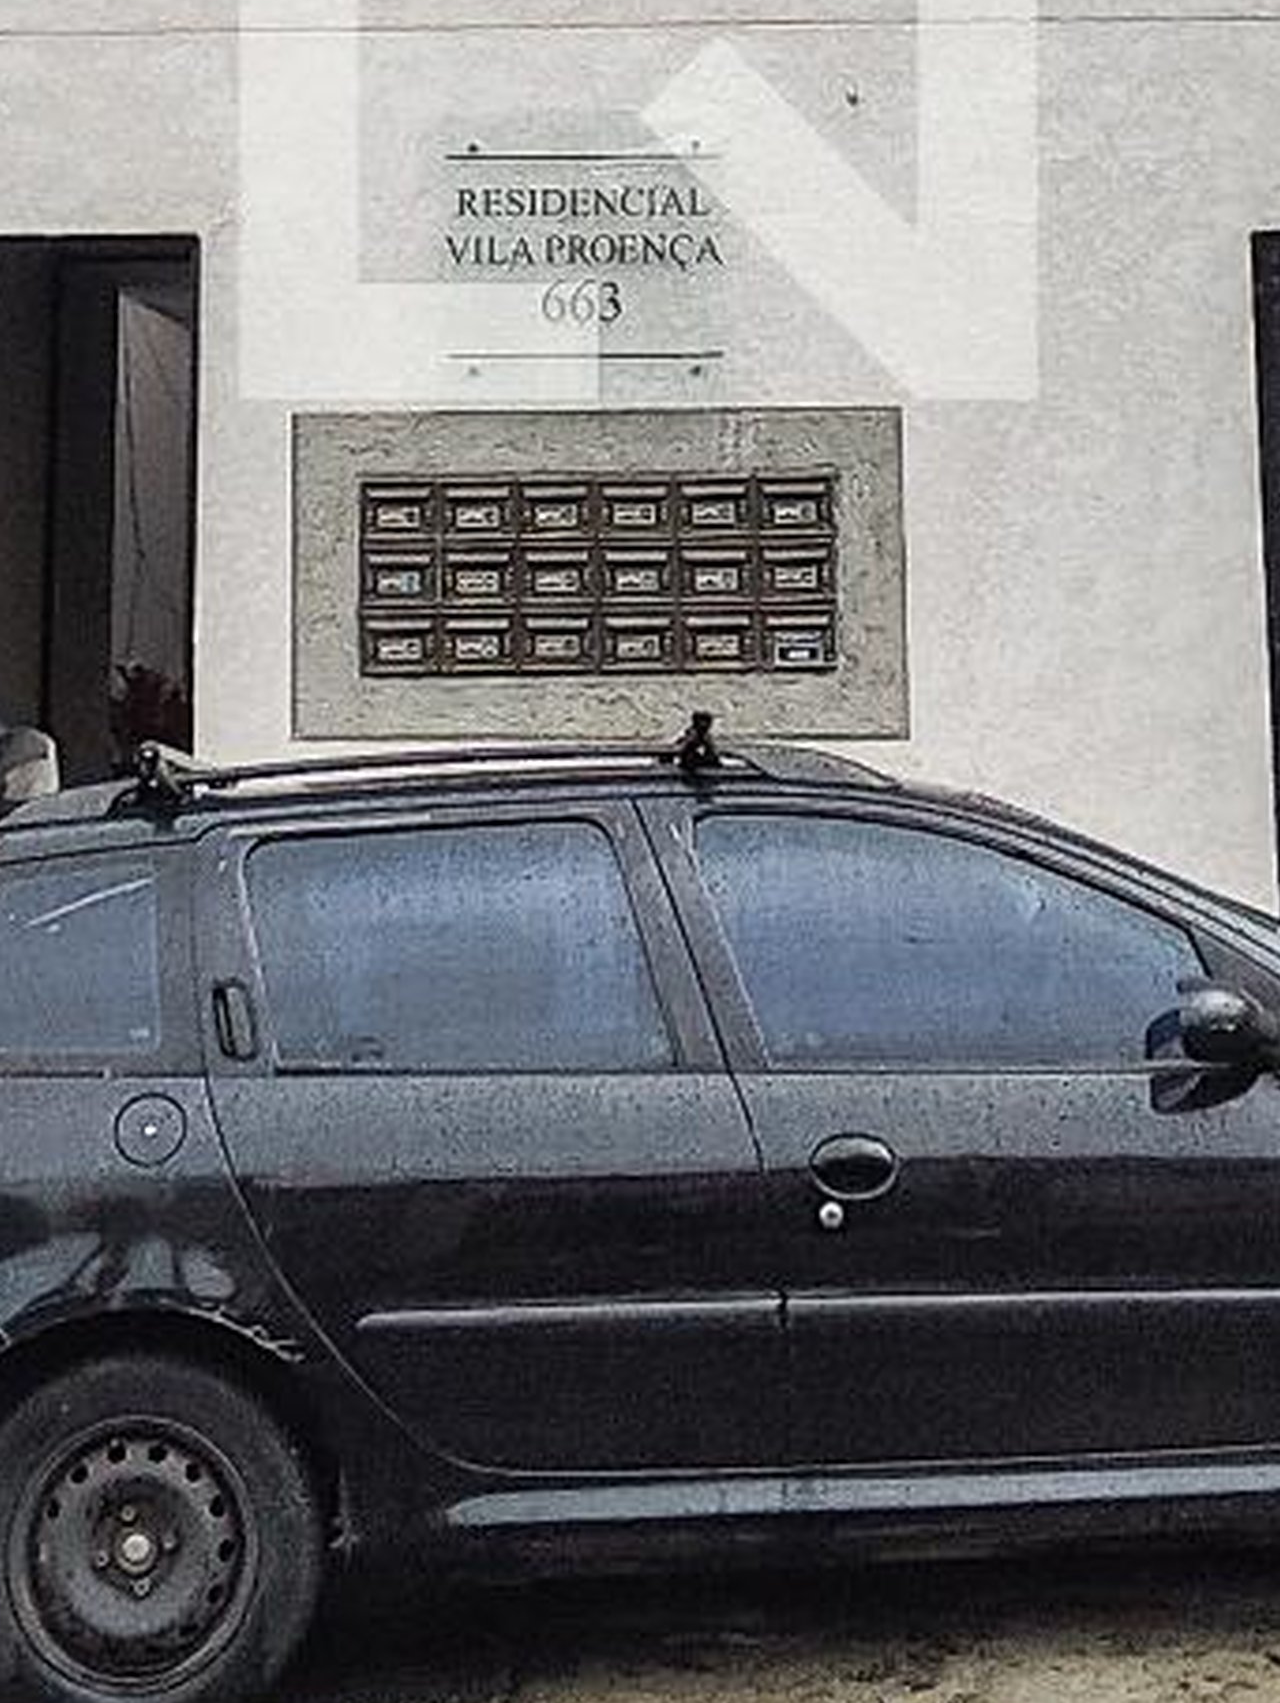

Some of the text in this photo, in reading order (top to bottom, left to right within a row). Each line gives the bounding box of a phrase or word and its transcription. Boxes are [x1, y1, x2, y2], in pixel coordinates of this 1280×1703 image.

[456, 188, 711, 218] RESIDENCIAL
[445, 234, 725, 270] VILA PROENÇA
[541, 280, 623, 325] 663
